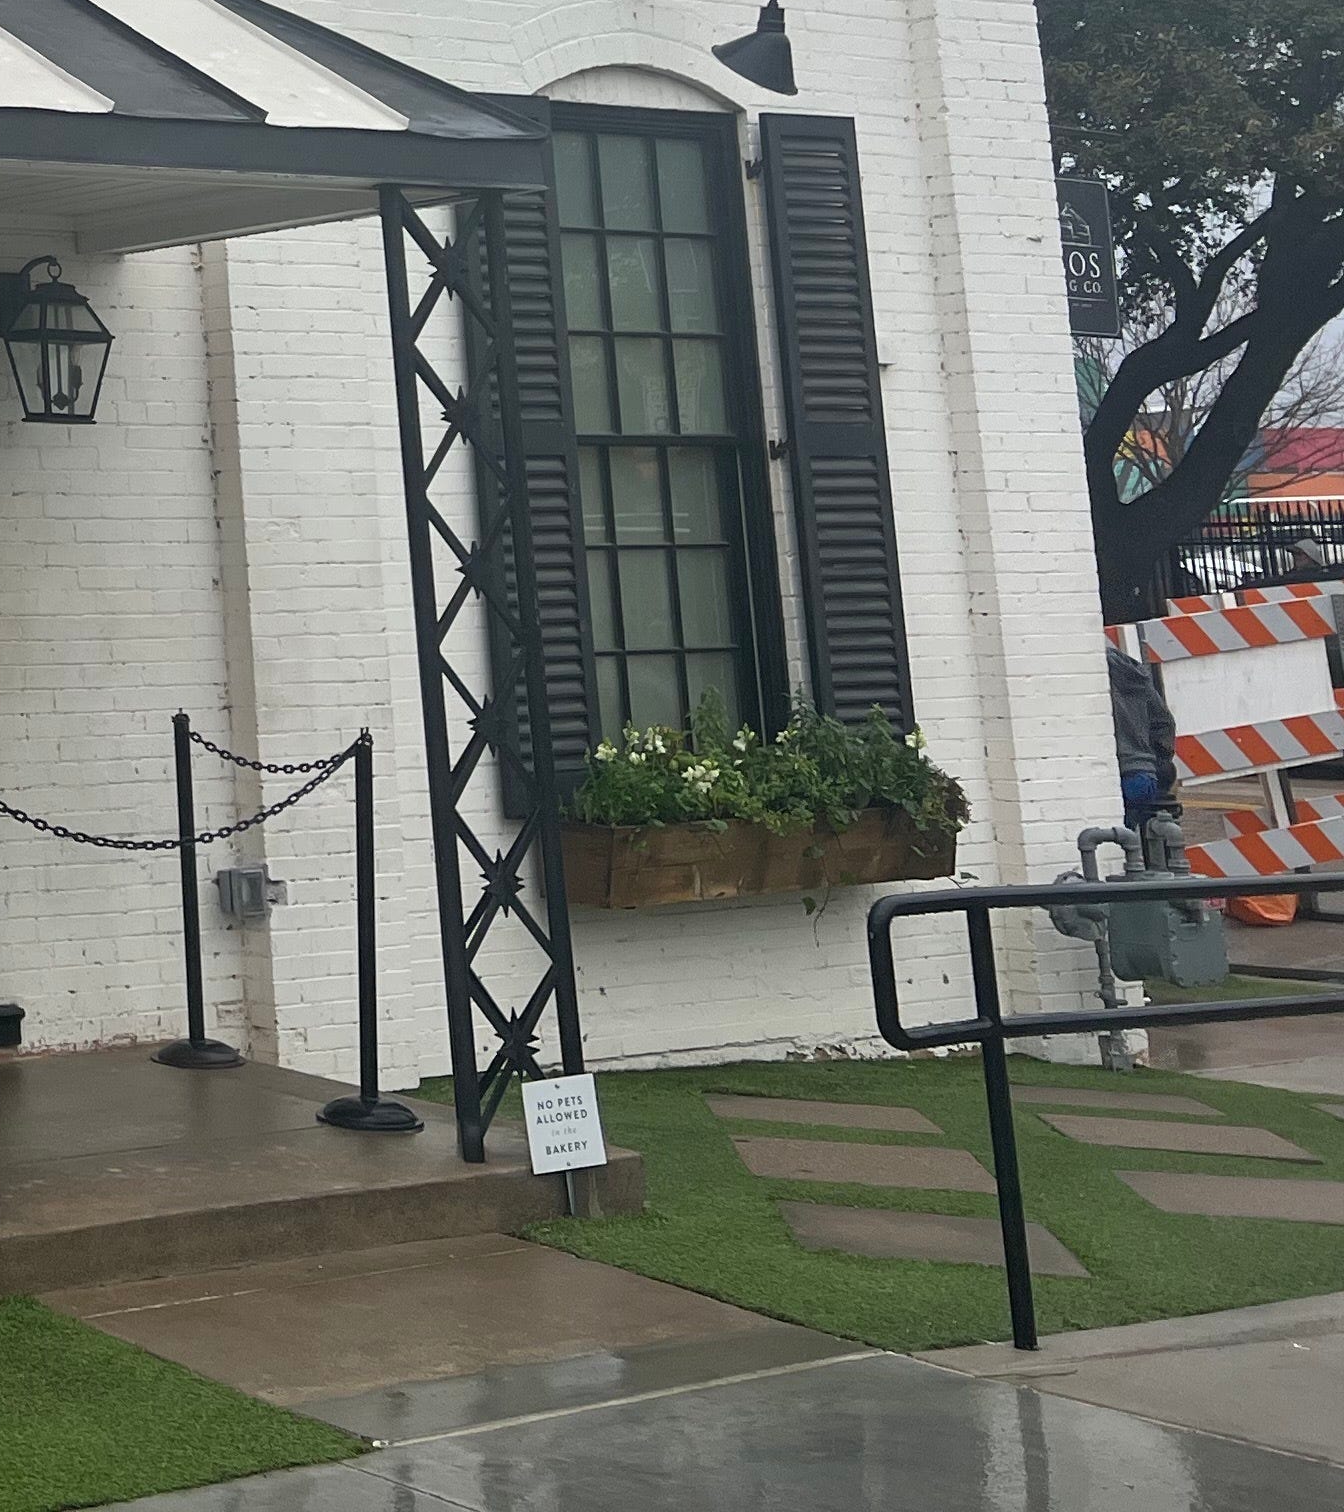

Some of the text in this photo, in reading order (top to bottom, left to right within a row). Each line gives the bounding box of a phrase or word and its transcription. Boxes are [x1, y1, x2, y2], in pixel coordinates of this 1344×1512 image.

[537, 1096, 583, 1110] NO PETS
[536, 1109, 588, 1125] ALLOWED
[564, 1125, 577, 1135] the
[545, 1140, 588, 1155] BAKERY
